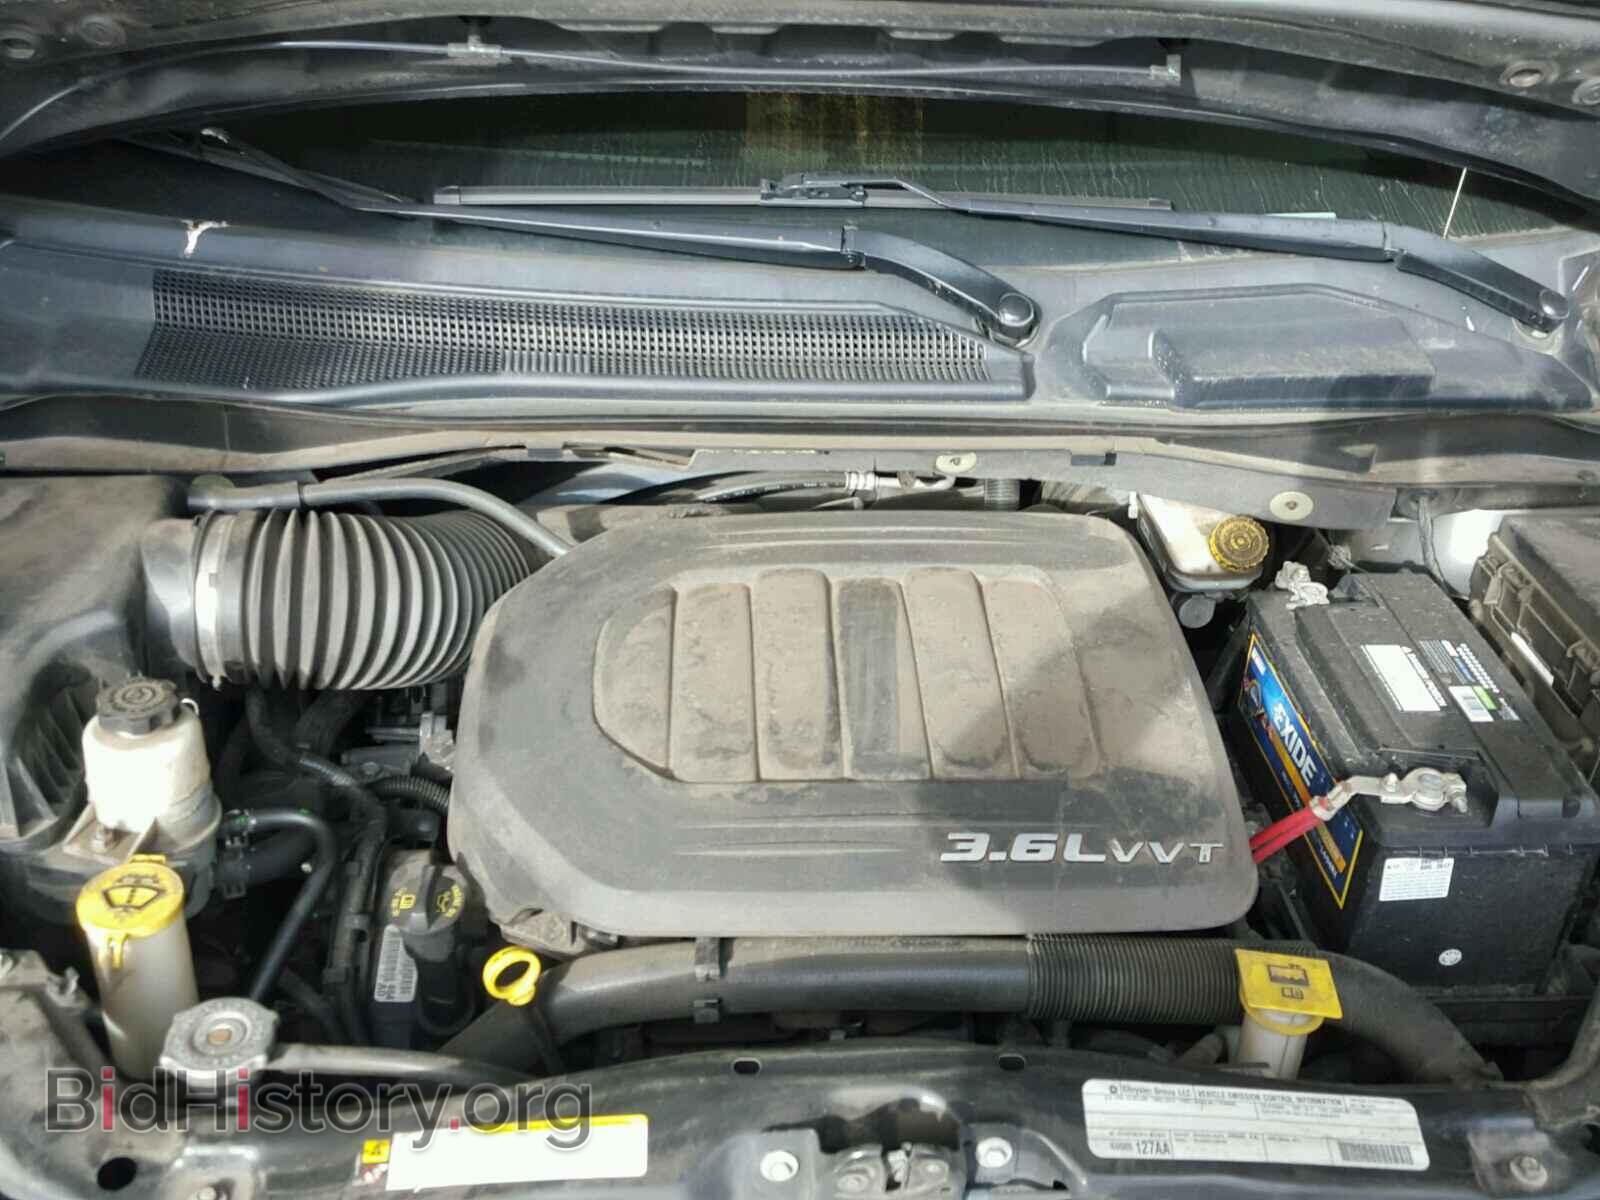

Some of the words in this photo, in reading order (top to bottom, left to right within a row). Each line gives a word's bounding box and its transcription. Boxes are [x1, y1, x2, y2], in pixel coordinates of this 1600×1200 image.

[1272, 702, 1318, 788] EXIDE
[1110, 837, 1225, 865] VVT
[1135, 1139, 1171, 1156] 127AA
